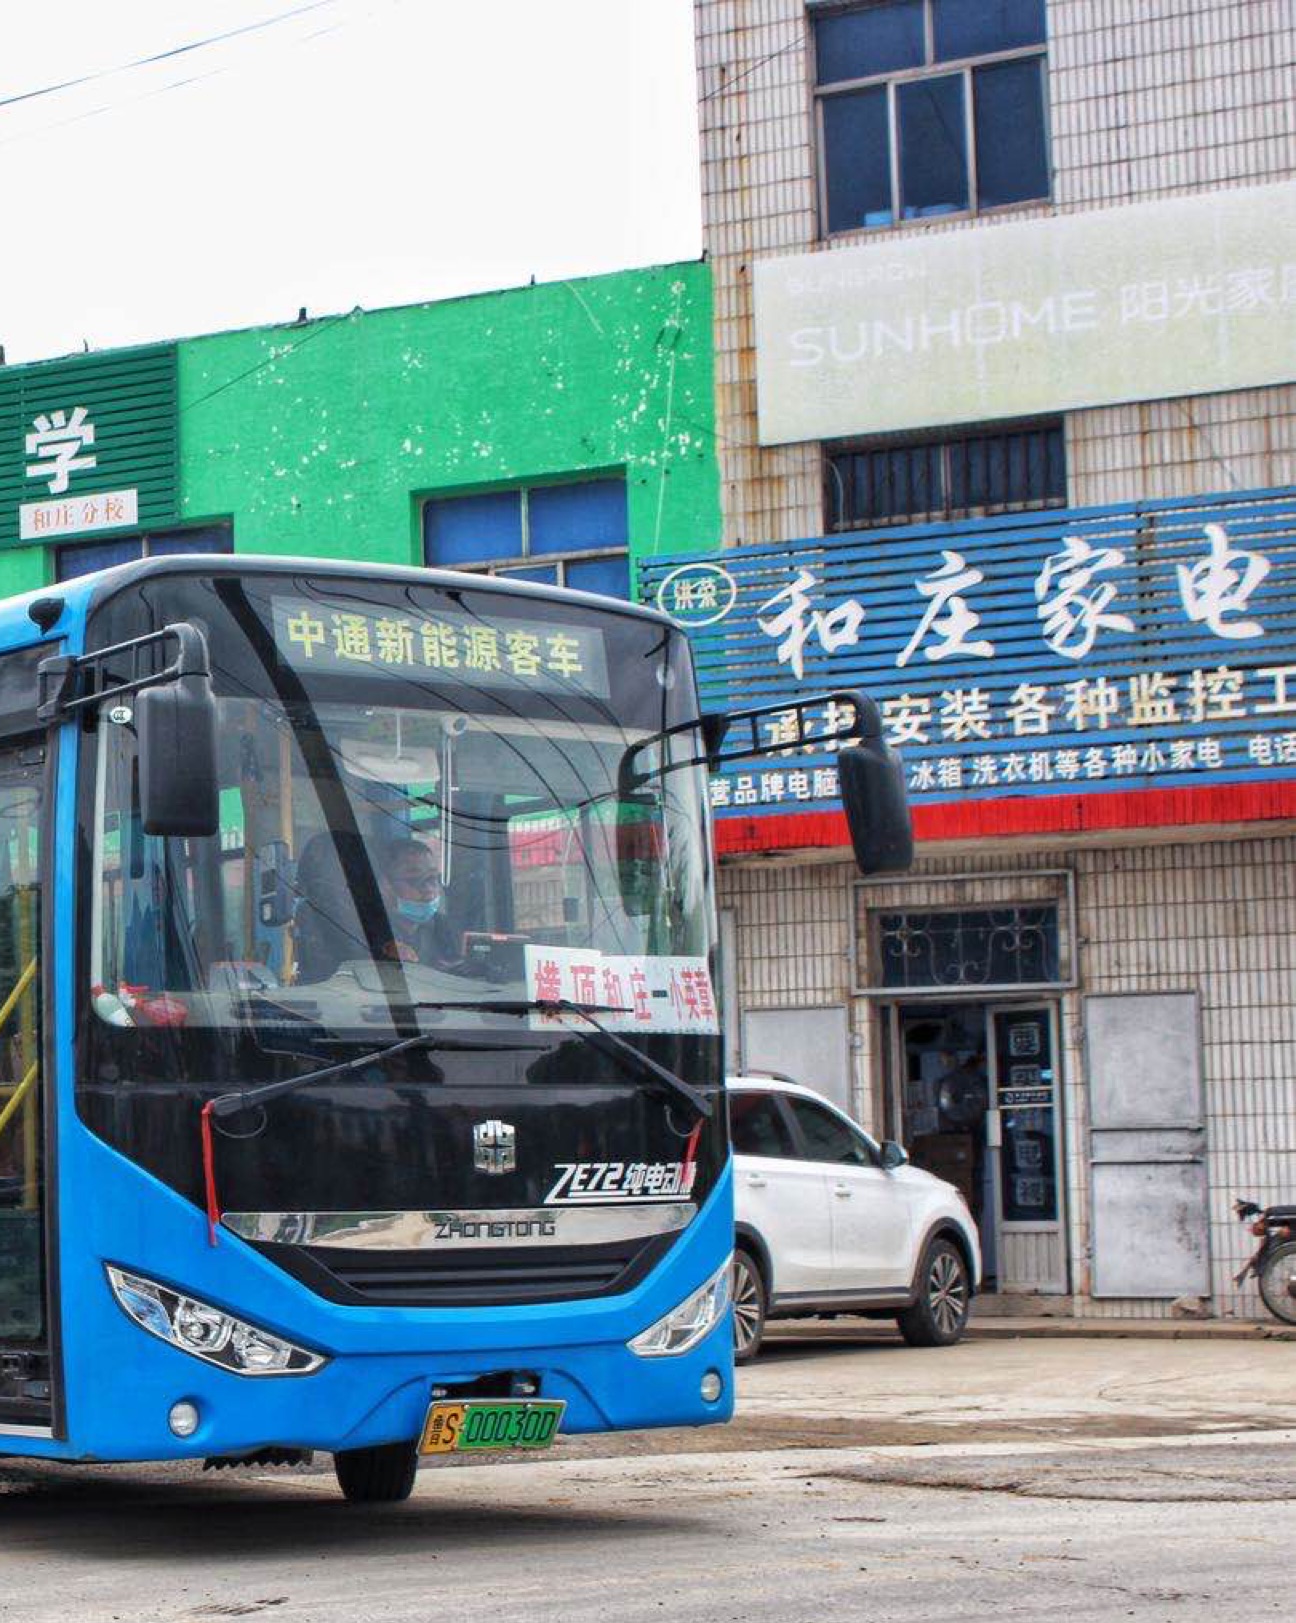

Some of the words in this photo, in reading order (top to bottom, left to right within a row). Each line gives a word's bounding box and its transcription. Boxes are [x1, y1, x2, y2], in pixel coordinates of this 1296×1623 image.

[789, 289, 1099, 367] SUNHOME
[33, 497, 124, 532] 和庄分校
[756, 524, 1271, 680] 和庄家电
[288, 610, 584, 678] 中通新能源客车
[910, 757, 962, 790] 冰箱
[544, 1162, 626, 1203] ZE72
[435, 1219, 556, 1240] ZHONGTONG
